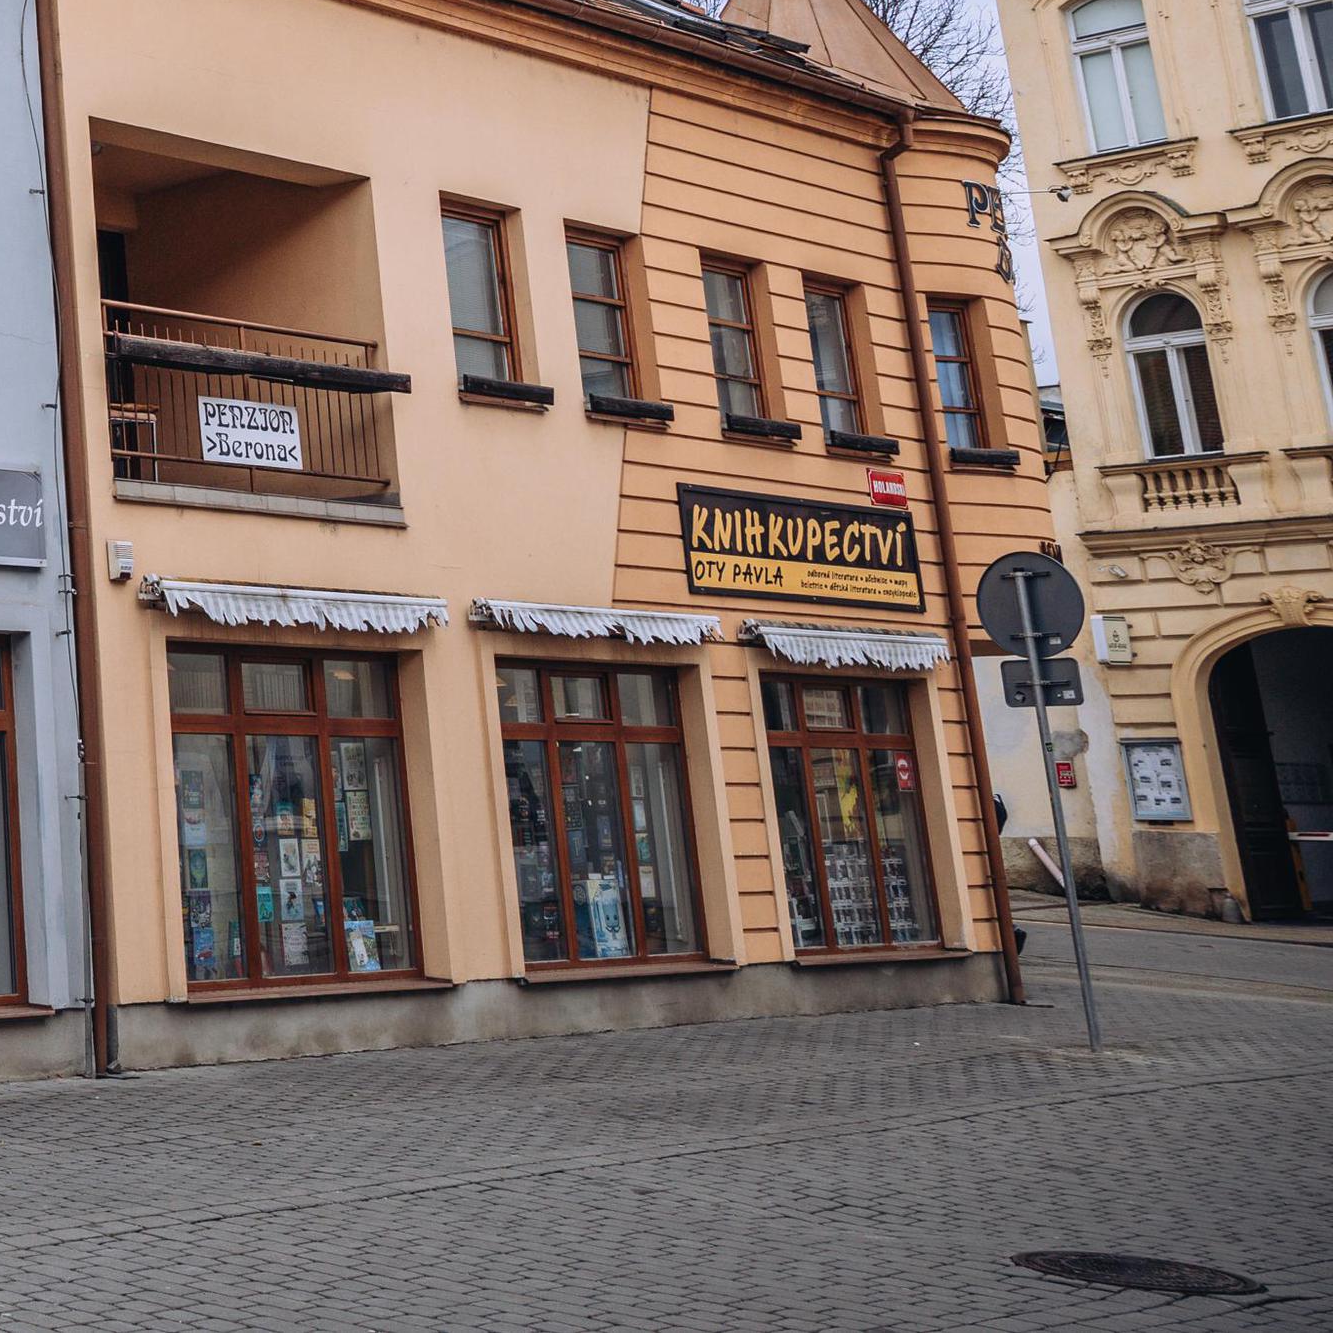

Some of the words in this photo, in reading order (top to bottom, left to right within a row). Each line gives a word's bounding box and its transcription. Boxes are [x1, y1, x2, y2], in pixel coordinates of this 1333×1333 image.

[691, 504, 906, 566] KNIHKUPECTVÍ
[694, 560, 726, 583] OTY
[733, 562, 783, 587] PAVLA
[831, 570, 860, 582] literatura
[850, 584, 877, 595] literatura
